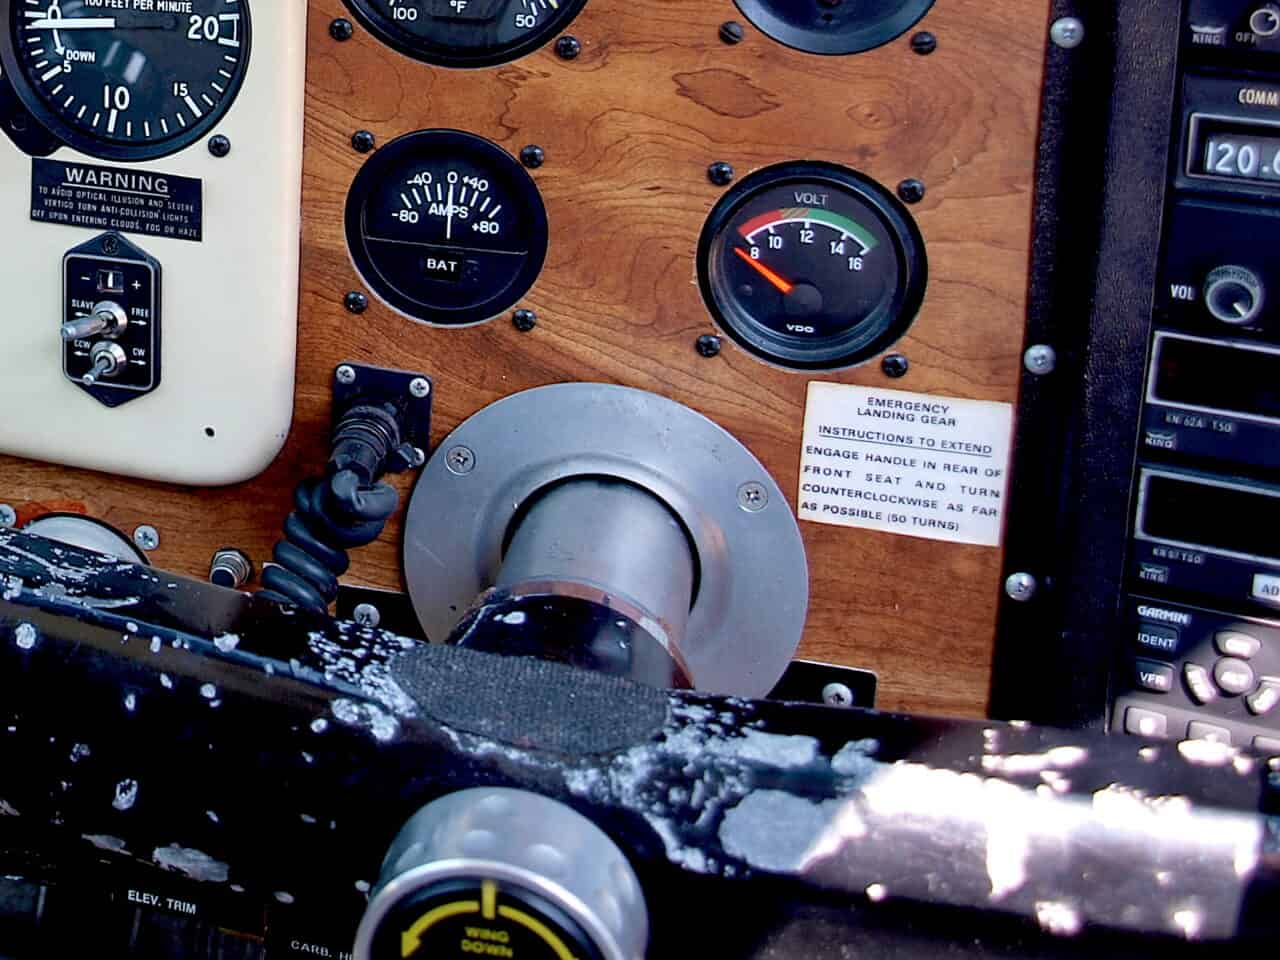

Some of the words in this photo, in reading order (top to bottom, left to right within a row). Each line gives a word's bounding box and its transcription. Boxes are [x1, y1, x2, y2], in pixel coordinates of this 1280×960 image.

[133, 0, 153, 10] PER
[157, 1, 192, 13] MINUTE
[393, 7, 417, 20] 100
[188, 16, 219, 40] 20
[515, 15, 536, 28] 50
[66, 51, 96, 62] DOWN
[174, 83, 188, 96] 15
[104, 85, 129, 110] 10
[65, 168, 168, 193] WARNING
[407, 172, 432, 185] -40
[448, 172, 457, 183] 0
[463, 176, 488, 191] +40
[76, 190, 107, 201] OPTICAL
[111, 196, 145, 205] ILLUSION
[148, 199, 163, 208] AND
[794, 192, 828, 205] VOLT
[392, 210, 418, 223] -80
[429, 204, 469, 218] AMPS
[472, 222, 499, 234] +80
[769, 237, 782, 249] 10
[800, 231, 814, 243] 12
[751, 247, 759, 259] 8
[831, 242, 844, 255] 14
[427, 259, 458, 272] BAT
[848, 257, 862, 270] 16
[1171, 284, 1193, 300] VOL
[787, 324, 814, 333] VDO
[868, 397, 950, 414] EMERGENCY
[857, 408, 915, 422] LANDING
[920, 415, 956, 427] GEAR
[819, 425, 913, 444] INSTRUCTIONS
[919, 437, 935, 447] TO
[941, 440, 992, 454] EXTEND
[806, 446, 859, 460] ENGAGE
[865, 453, 916, 467] HANDLE
[923, 461, 936, 469] IN
[943, 464, 978, 475] REAR
[984, 469, 1001, 477] OF
[804, 465, 852, 478] FRONT
[866, 474, 902, 485] SEAT
[915, 480, 946, 491] AND
[960, 485, 1000, 498] TURN
[802, 484, 937, 509] COUNTERCLOCKWISE
[947, 503, 964, 512] AS
[972, 506, 997, 517] FAR
[801, 502, 817, 511] AS
[823, 505, 882, 520] POSSIBLE
[887, 514, 907, 523] (50
[913, 517, 959, 531] TURNS)
[1138, 605, 1188, 624] GARMIN
[1138, 632, 1174, 648] IDENT
[1140, 672, 1164, 684] VFR
[128, 890, 161, 907] ELEV.
[167, 898, 196, 914] TRIM
[462, 940, 512, 958] DOWN
